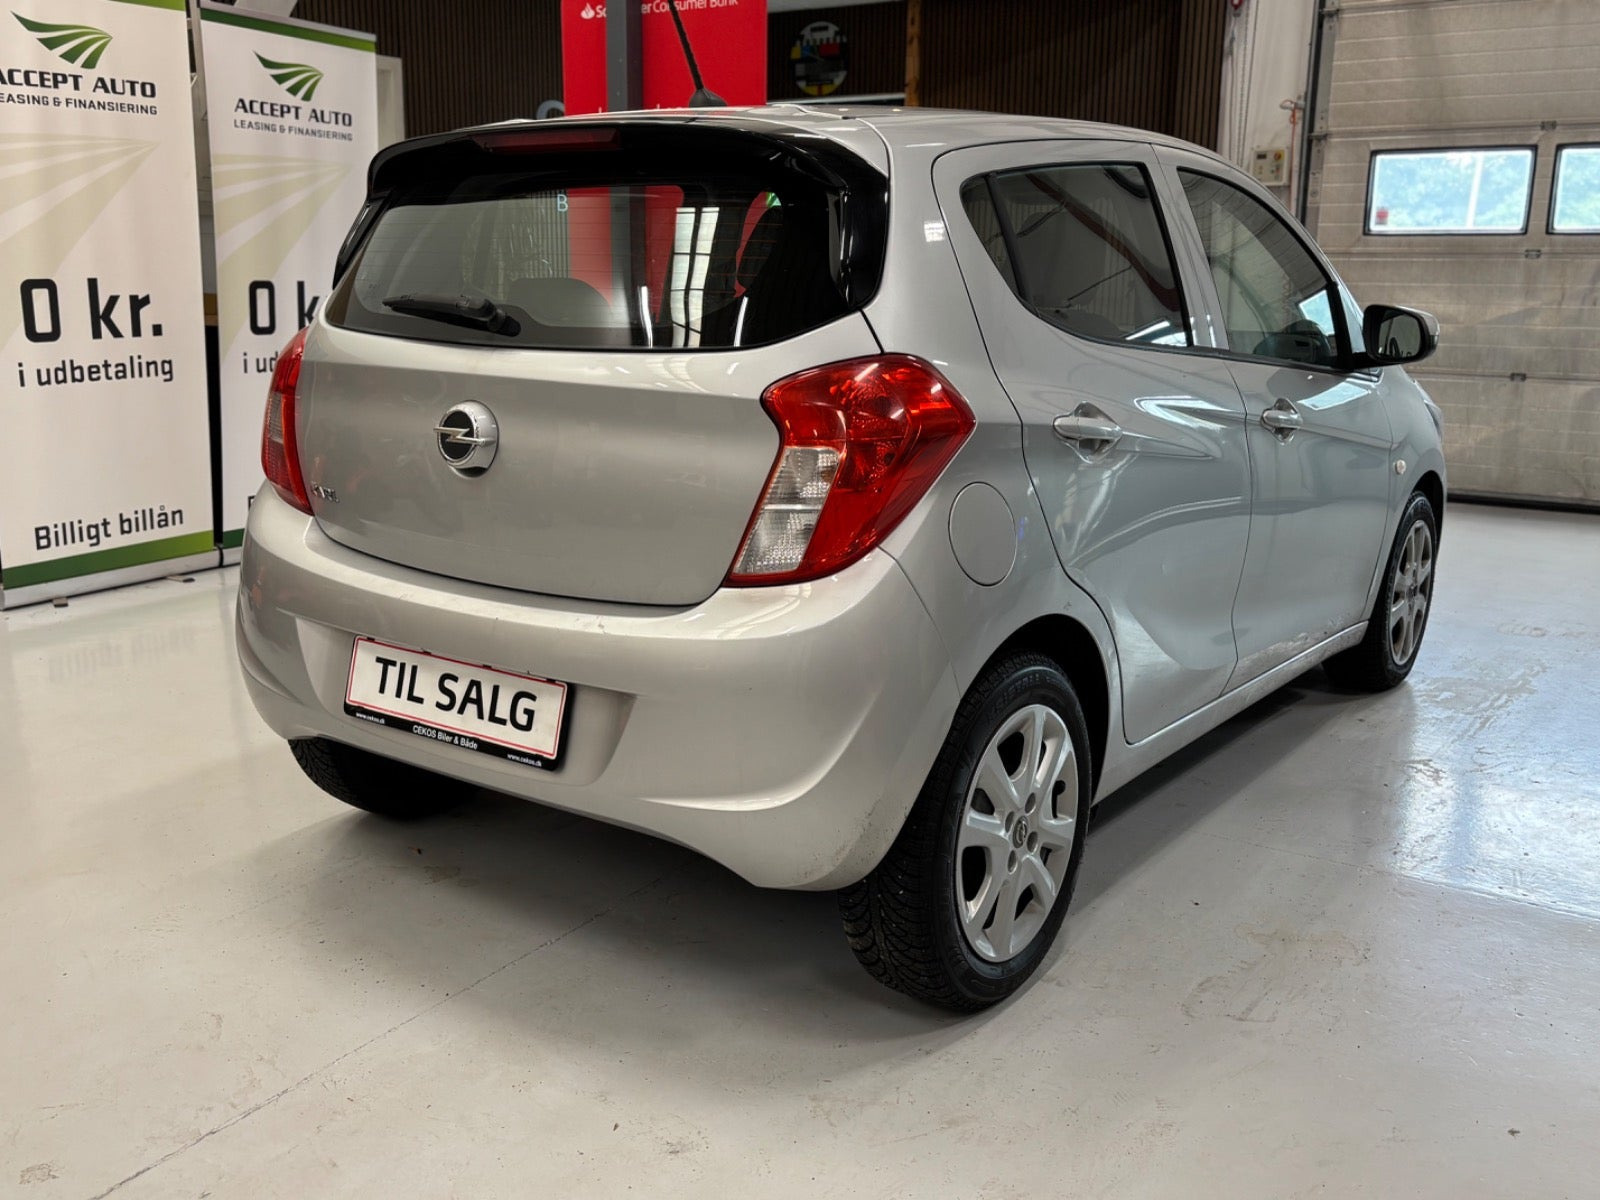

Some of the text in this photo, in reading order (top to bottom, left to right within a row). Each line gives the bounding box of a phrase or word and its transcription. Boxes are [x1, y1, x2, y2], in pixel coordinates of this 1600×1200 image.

[92, 77, 157, 98] AUTO
[53, 97, 62, 107] &
[65, 98, 158, 115] FINANSIERING
[234, 98, 352, 127] ACCEPT AUTO
[233, 119, 353, 141] LEASING & FINANSIERING
[557, 194, 569, 211] B
[87, 278, 163, 340] kr.
[17, 355, 174, 387] i udbetaling
[243, 352, 248, 374] i
[34, 505, 184, 551] Billigt billån
[375, 656, 538, 732] TIL SALG
[412, 725, 437, 738] CEKOS
[437, 731, 453, 743] Biler
[453, 736, 459, 745] &
